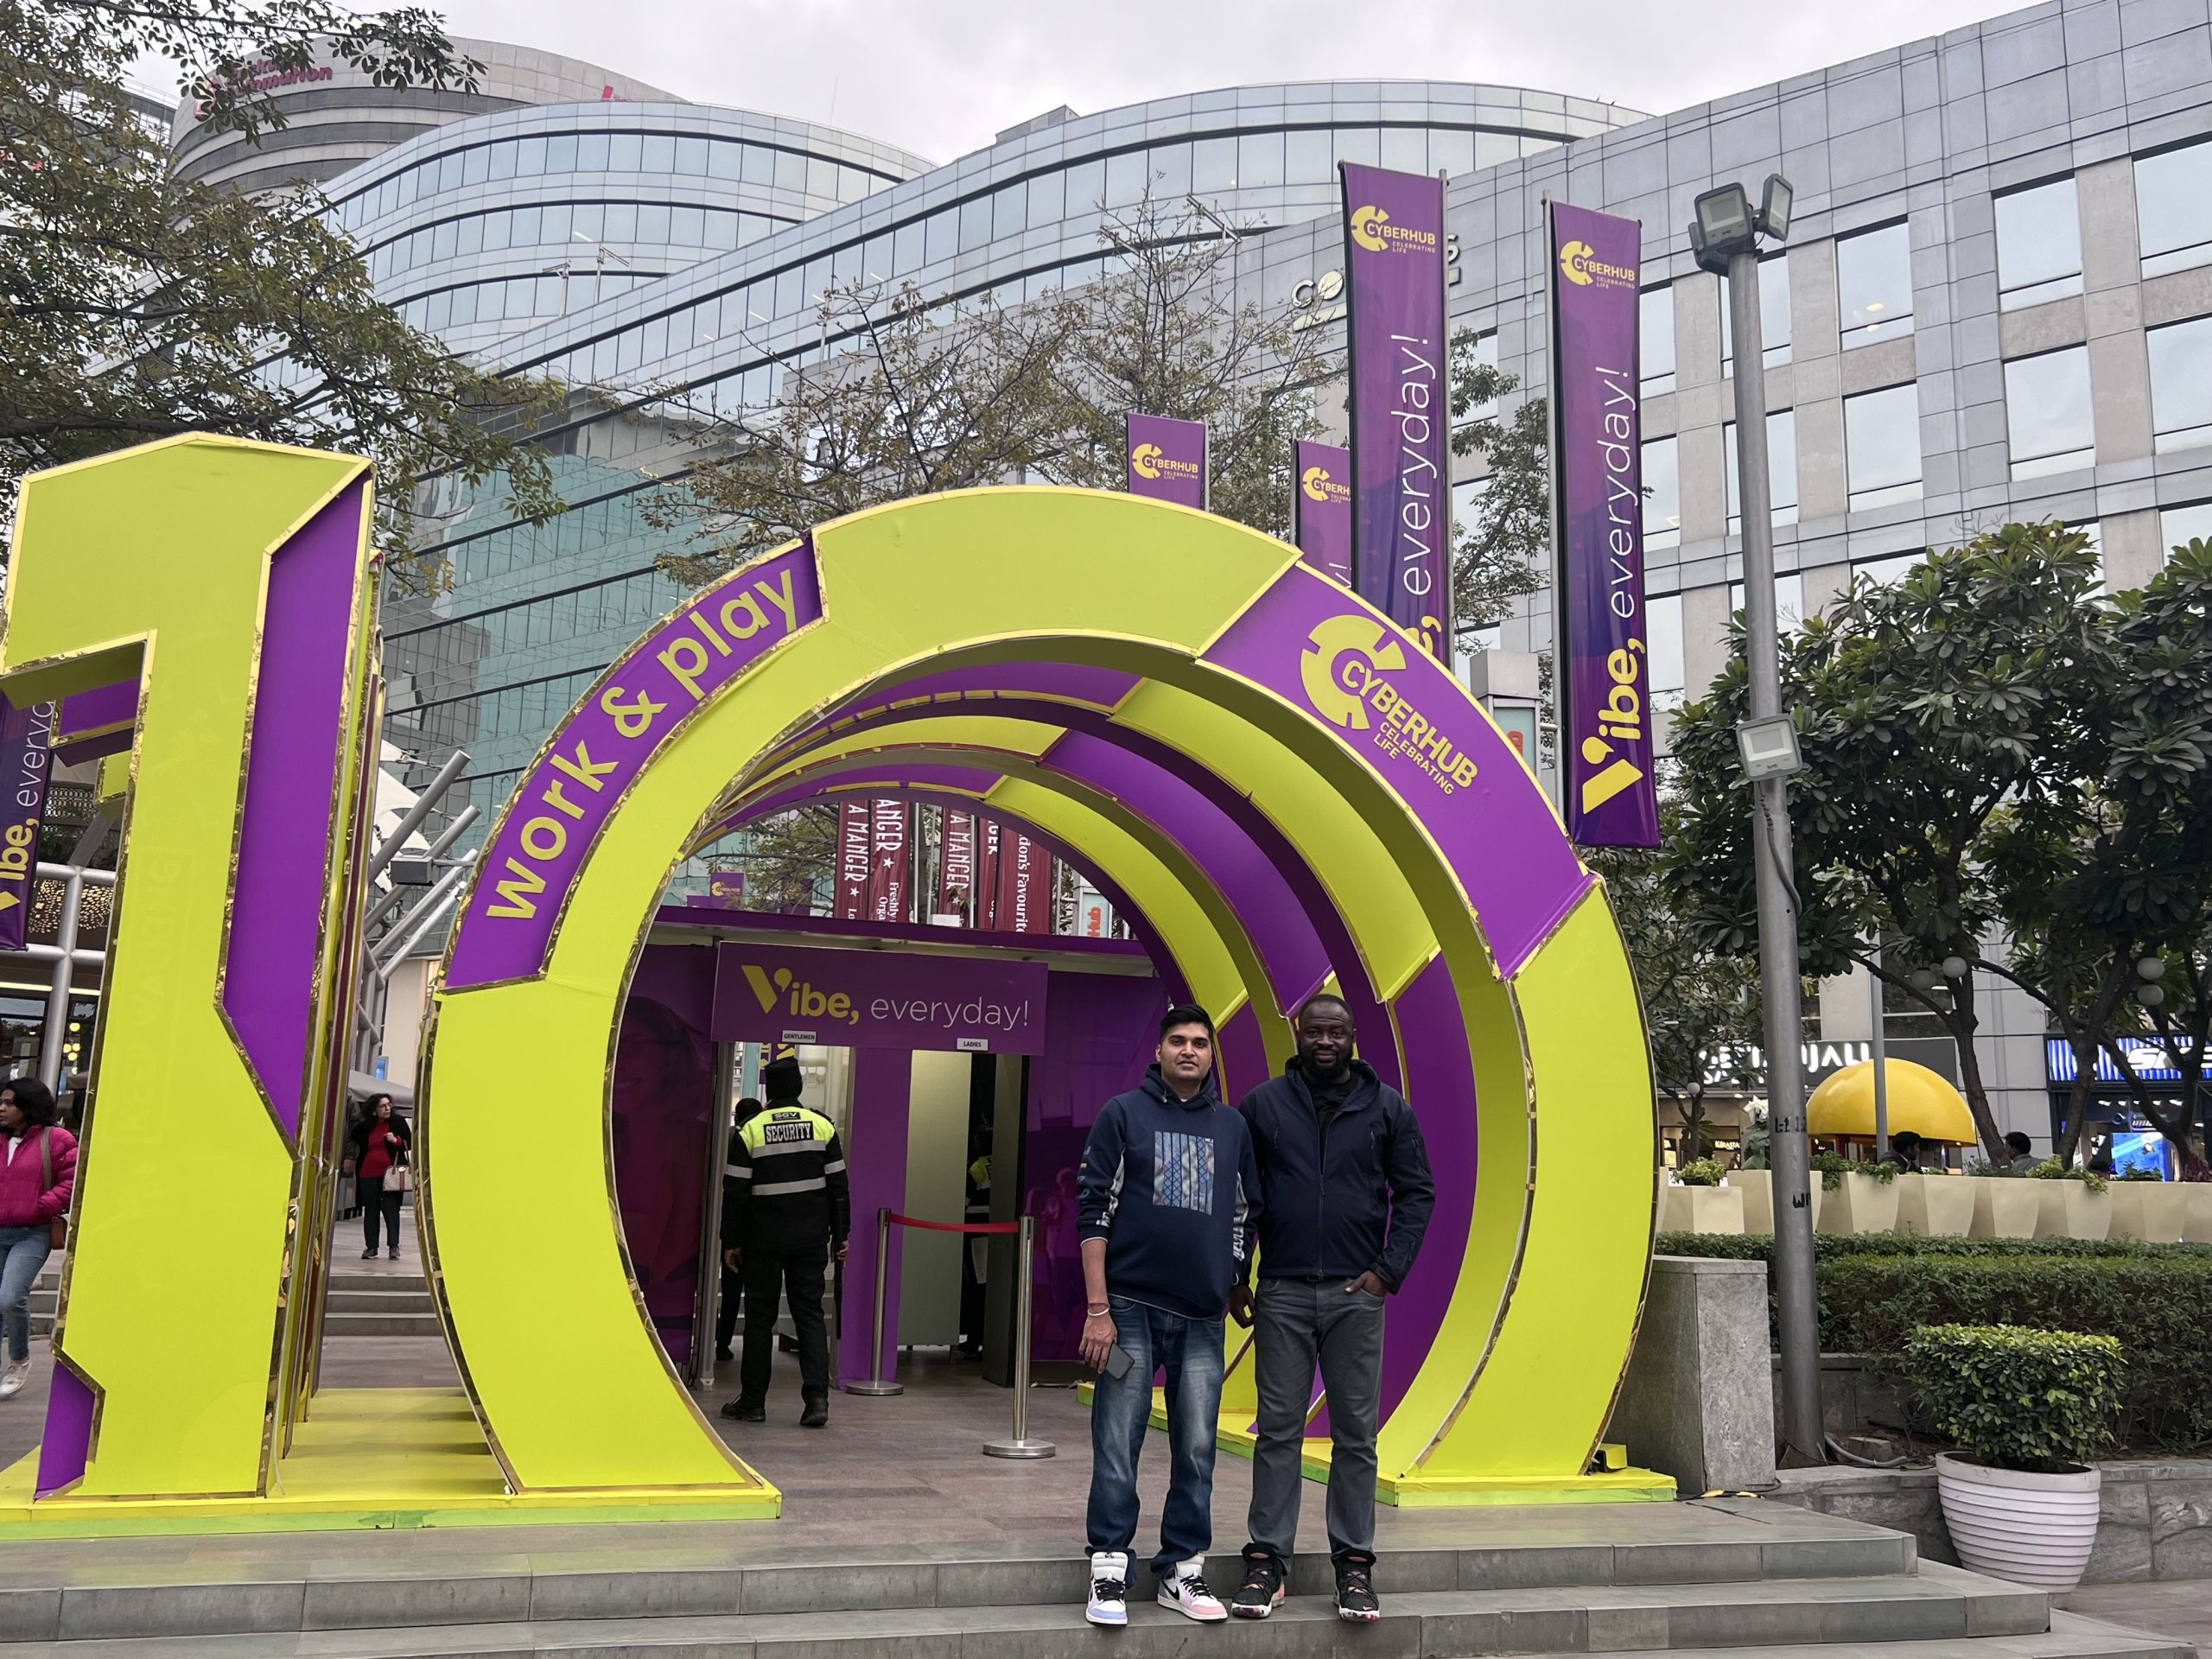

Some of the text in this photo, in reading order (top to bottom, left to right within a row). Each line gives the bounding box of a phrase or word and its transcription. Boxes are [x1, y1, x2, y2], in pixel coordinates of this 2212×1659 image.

[1366, 222, 1436, 245] CYBERHUB
[1392, 240, 1436, 254] CELEBRATING
[1573, 257, 1636, 282] CYBERHUB
[1596, 276, 1635, 289] CELEBRATING
[1144, 456, 1198, 474] CYBERHUB
[1390, 334, 1438, 596] everyday!
[1313, 480, 1351, 495] CYBERH
[1595, 365, 1639, 620] everyday!
[1342, 659, 1478, 788] CYBERHUB
[486, 569, 798, 920] work & play
[1373, 734, 1401, 760] LIFE
[1379, 721, 1454, 795] CELEBRATING
[875, 798, 904, 852] ANGER
[876, 896, 888, 920] Orga
[889, 881, 899, 918] Freshly
[741, 964, 1029, 1031] Vibe, everyday!
[766, 1122, 811, 1142] SECURITY
